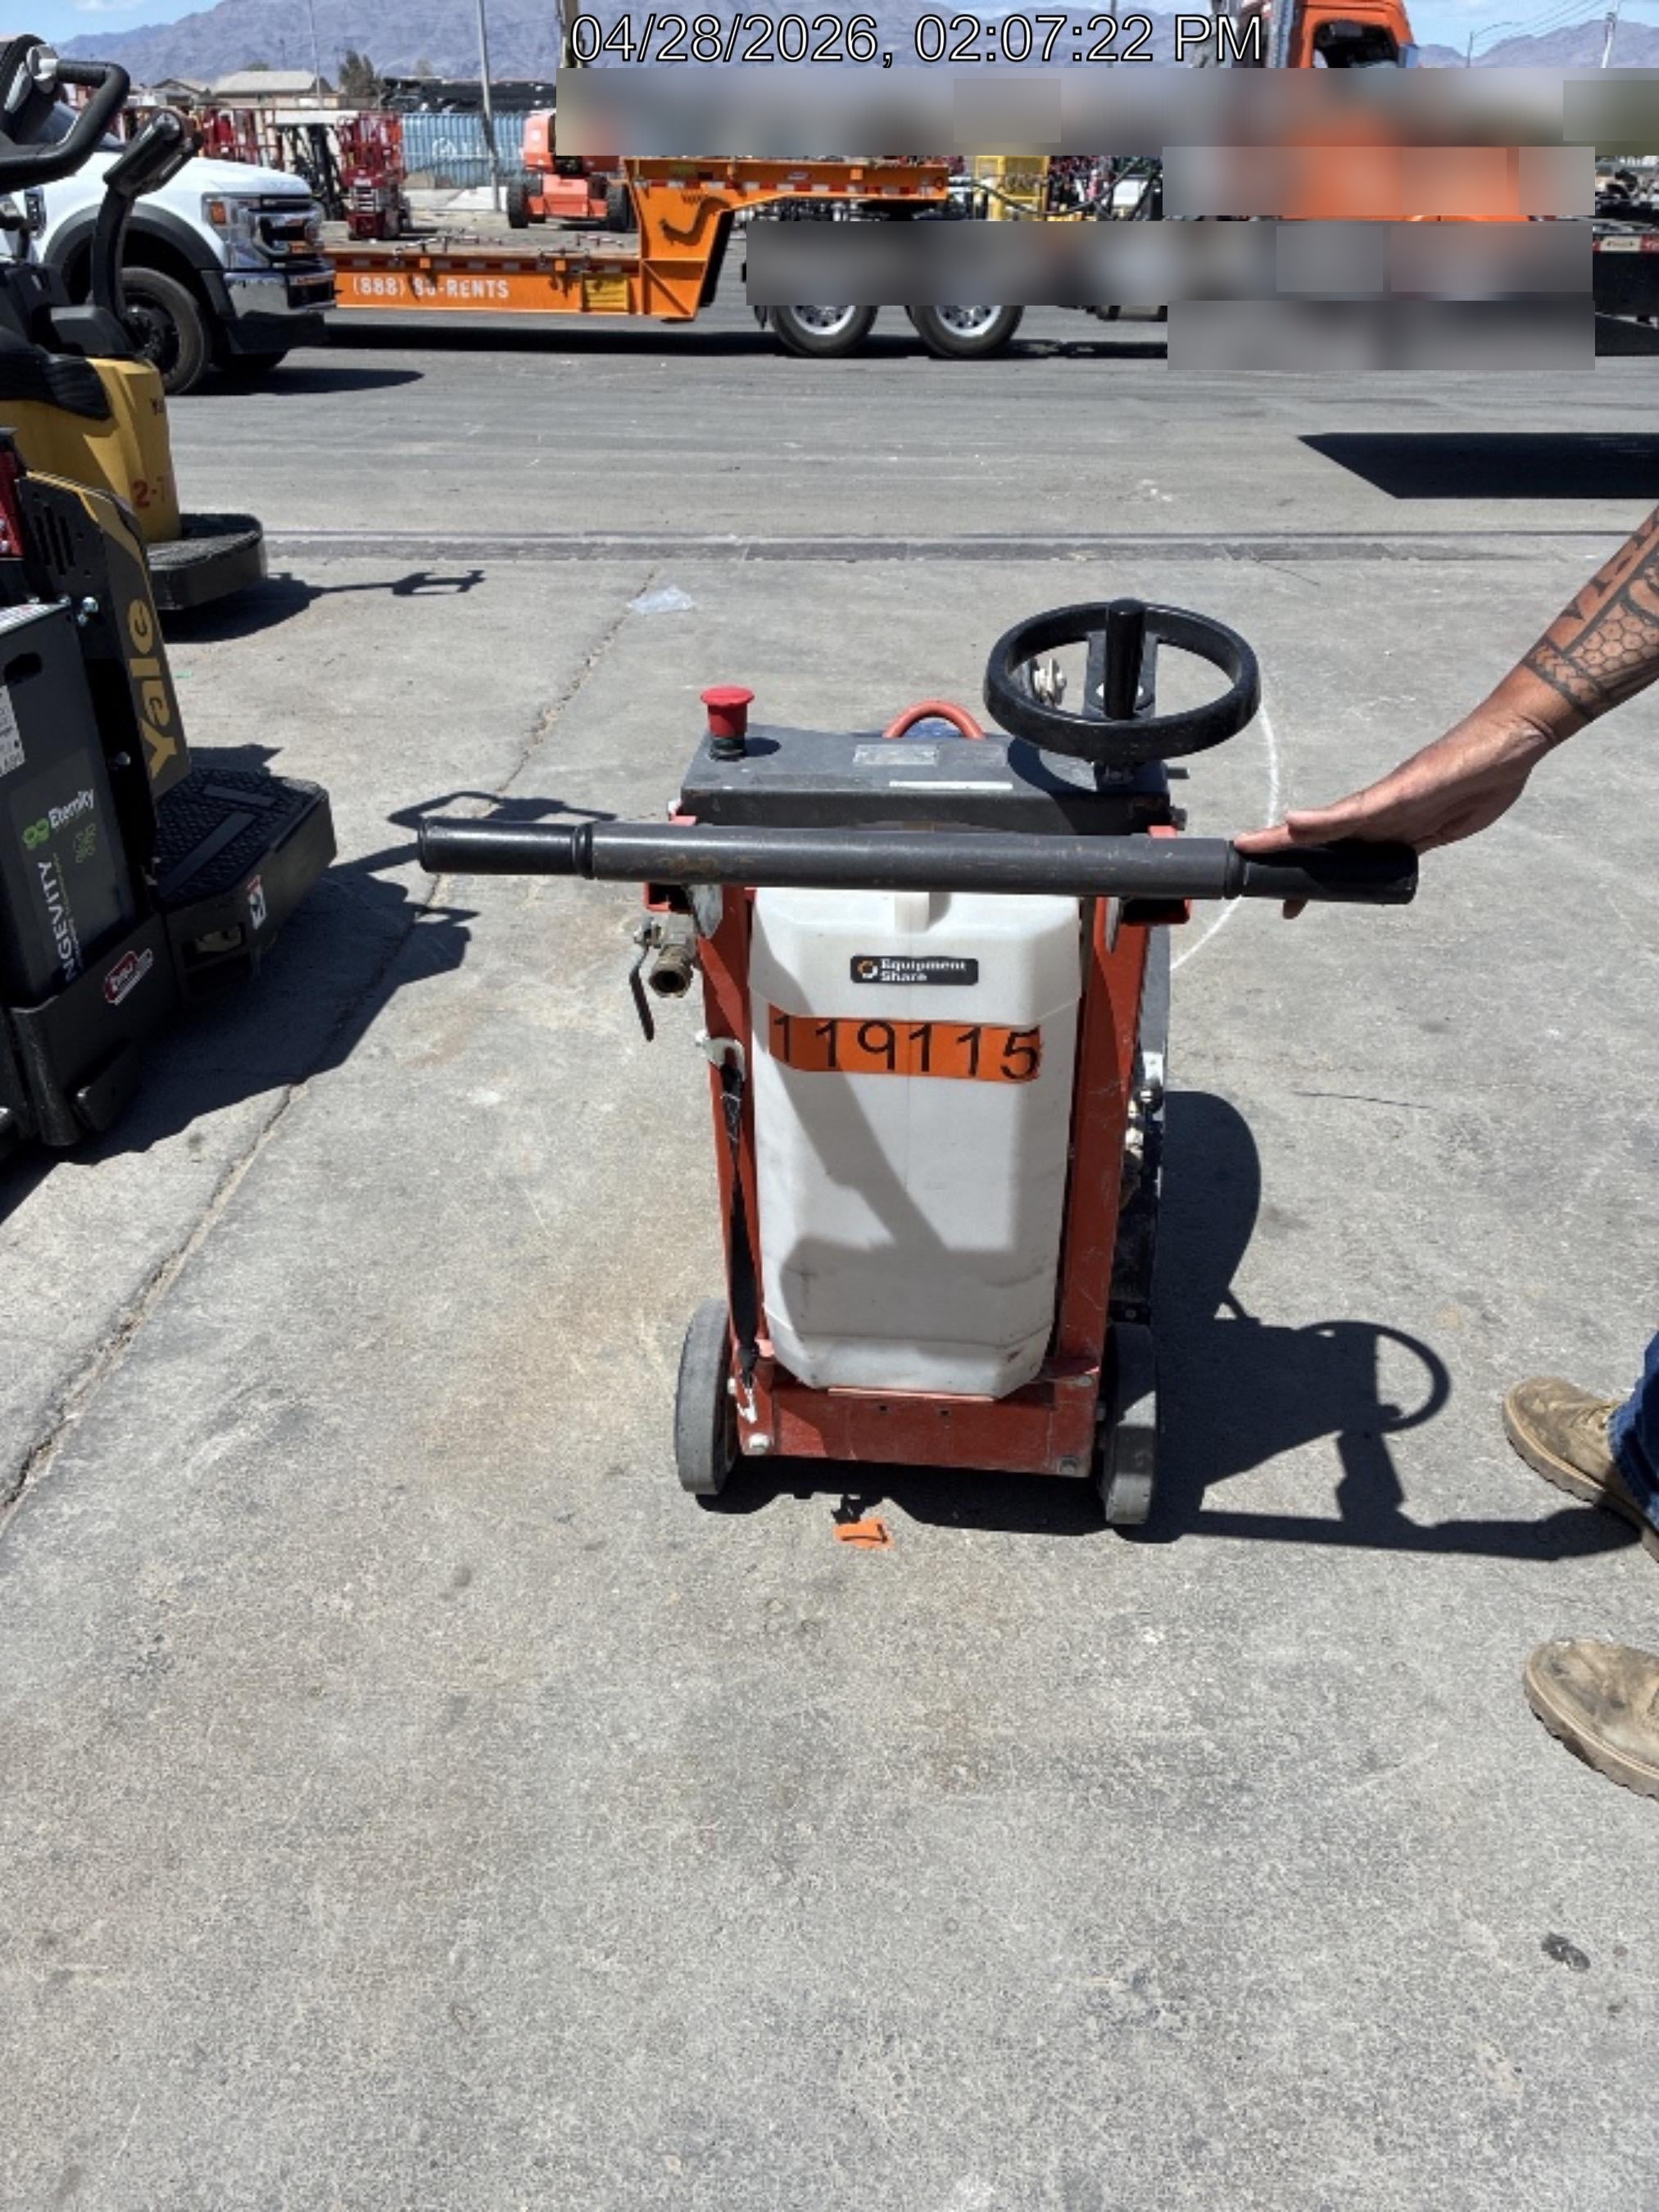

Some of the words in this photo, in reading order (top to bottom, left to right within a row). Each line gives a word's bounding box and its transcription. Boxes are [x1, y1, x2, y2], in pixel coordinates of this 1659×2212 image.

[353, 275, 405, 297] (888)
[127, 599, 178, 781] Yale
[48, 788, 94, 830] Eternity
[879, 970, 927, 982] Share
[880, 957, 968, 972] Equipment
[774, 1014, 1040, 1080] 119115
